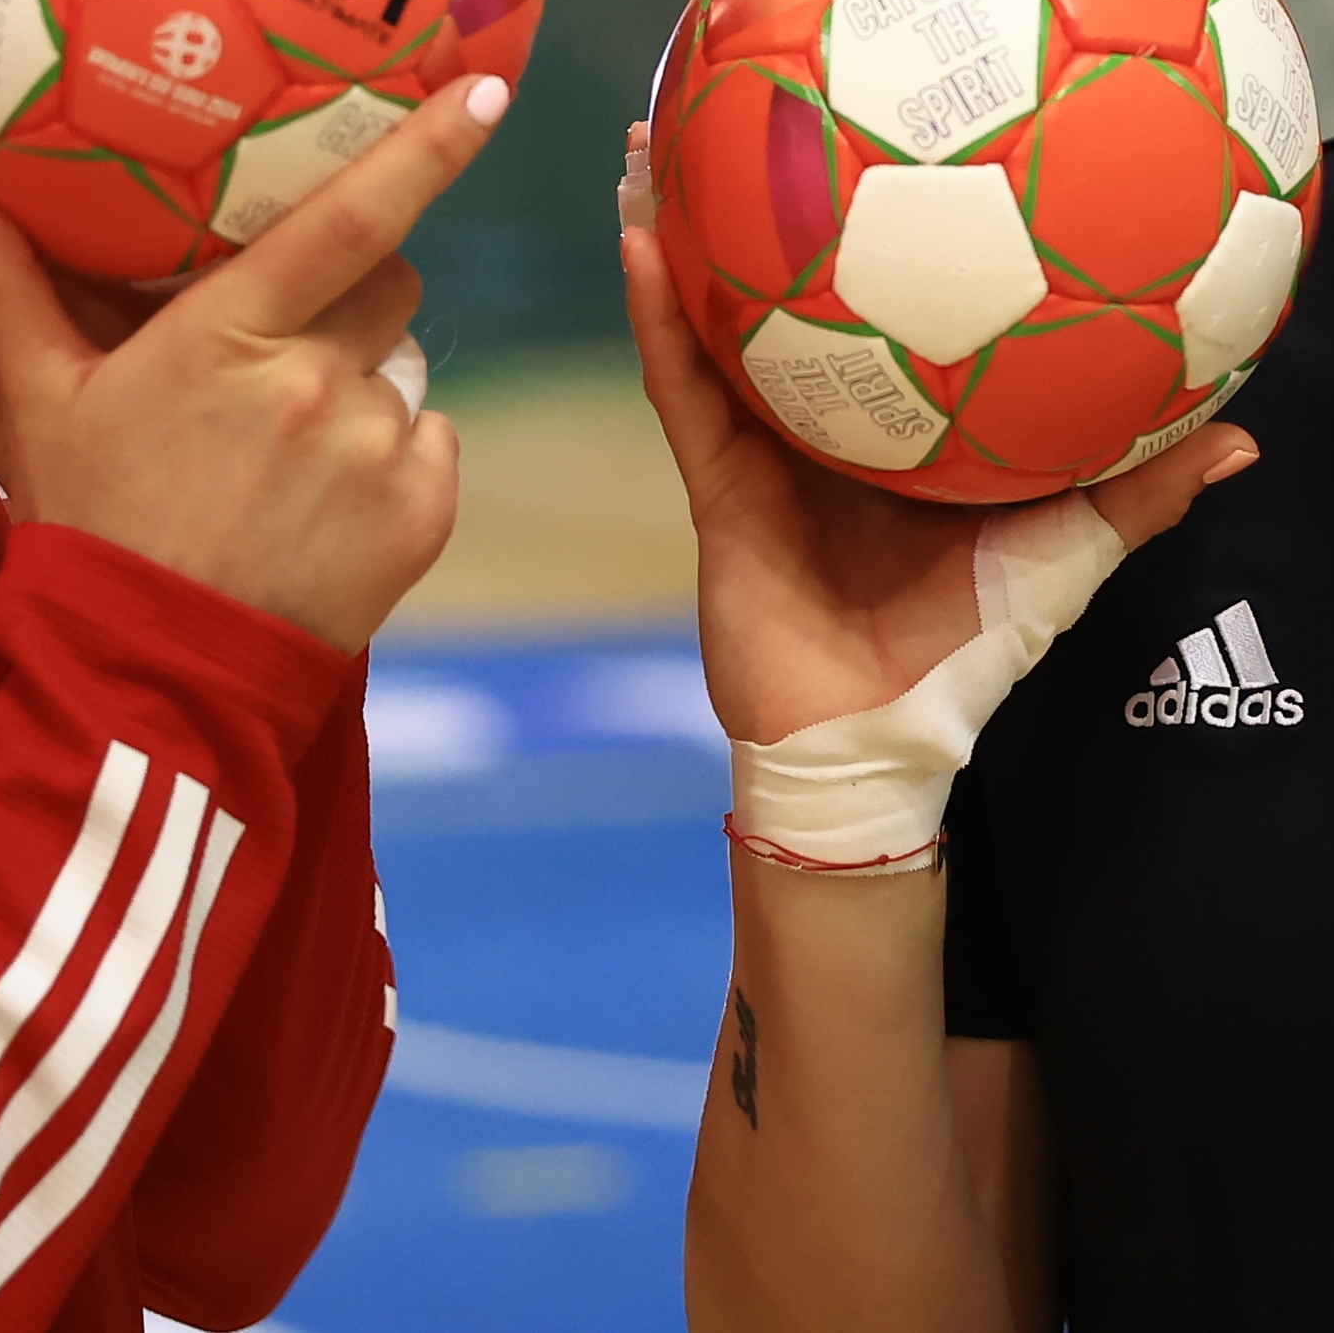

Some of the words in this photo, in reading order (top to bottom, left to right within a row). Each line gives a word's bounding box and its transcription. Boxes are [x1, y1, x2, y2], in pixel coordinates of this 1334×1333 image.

[897, 45, 1025, 151] SPIRIT
[1235, 73, 1305, 180] SPIRIT
[782, 357, 849, 416] THE
[826, 348, 934, 440] SPIRIT
[1125, 680, 1304, 728] adidas
